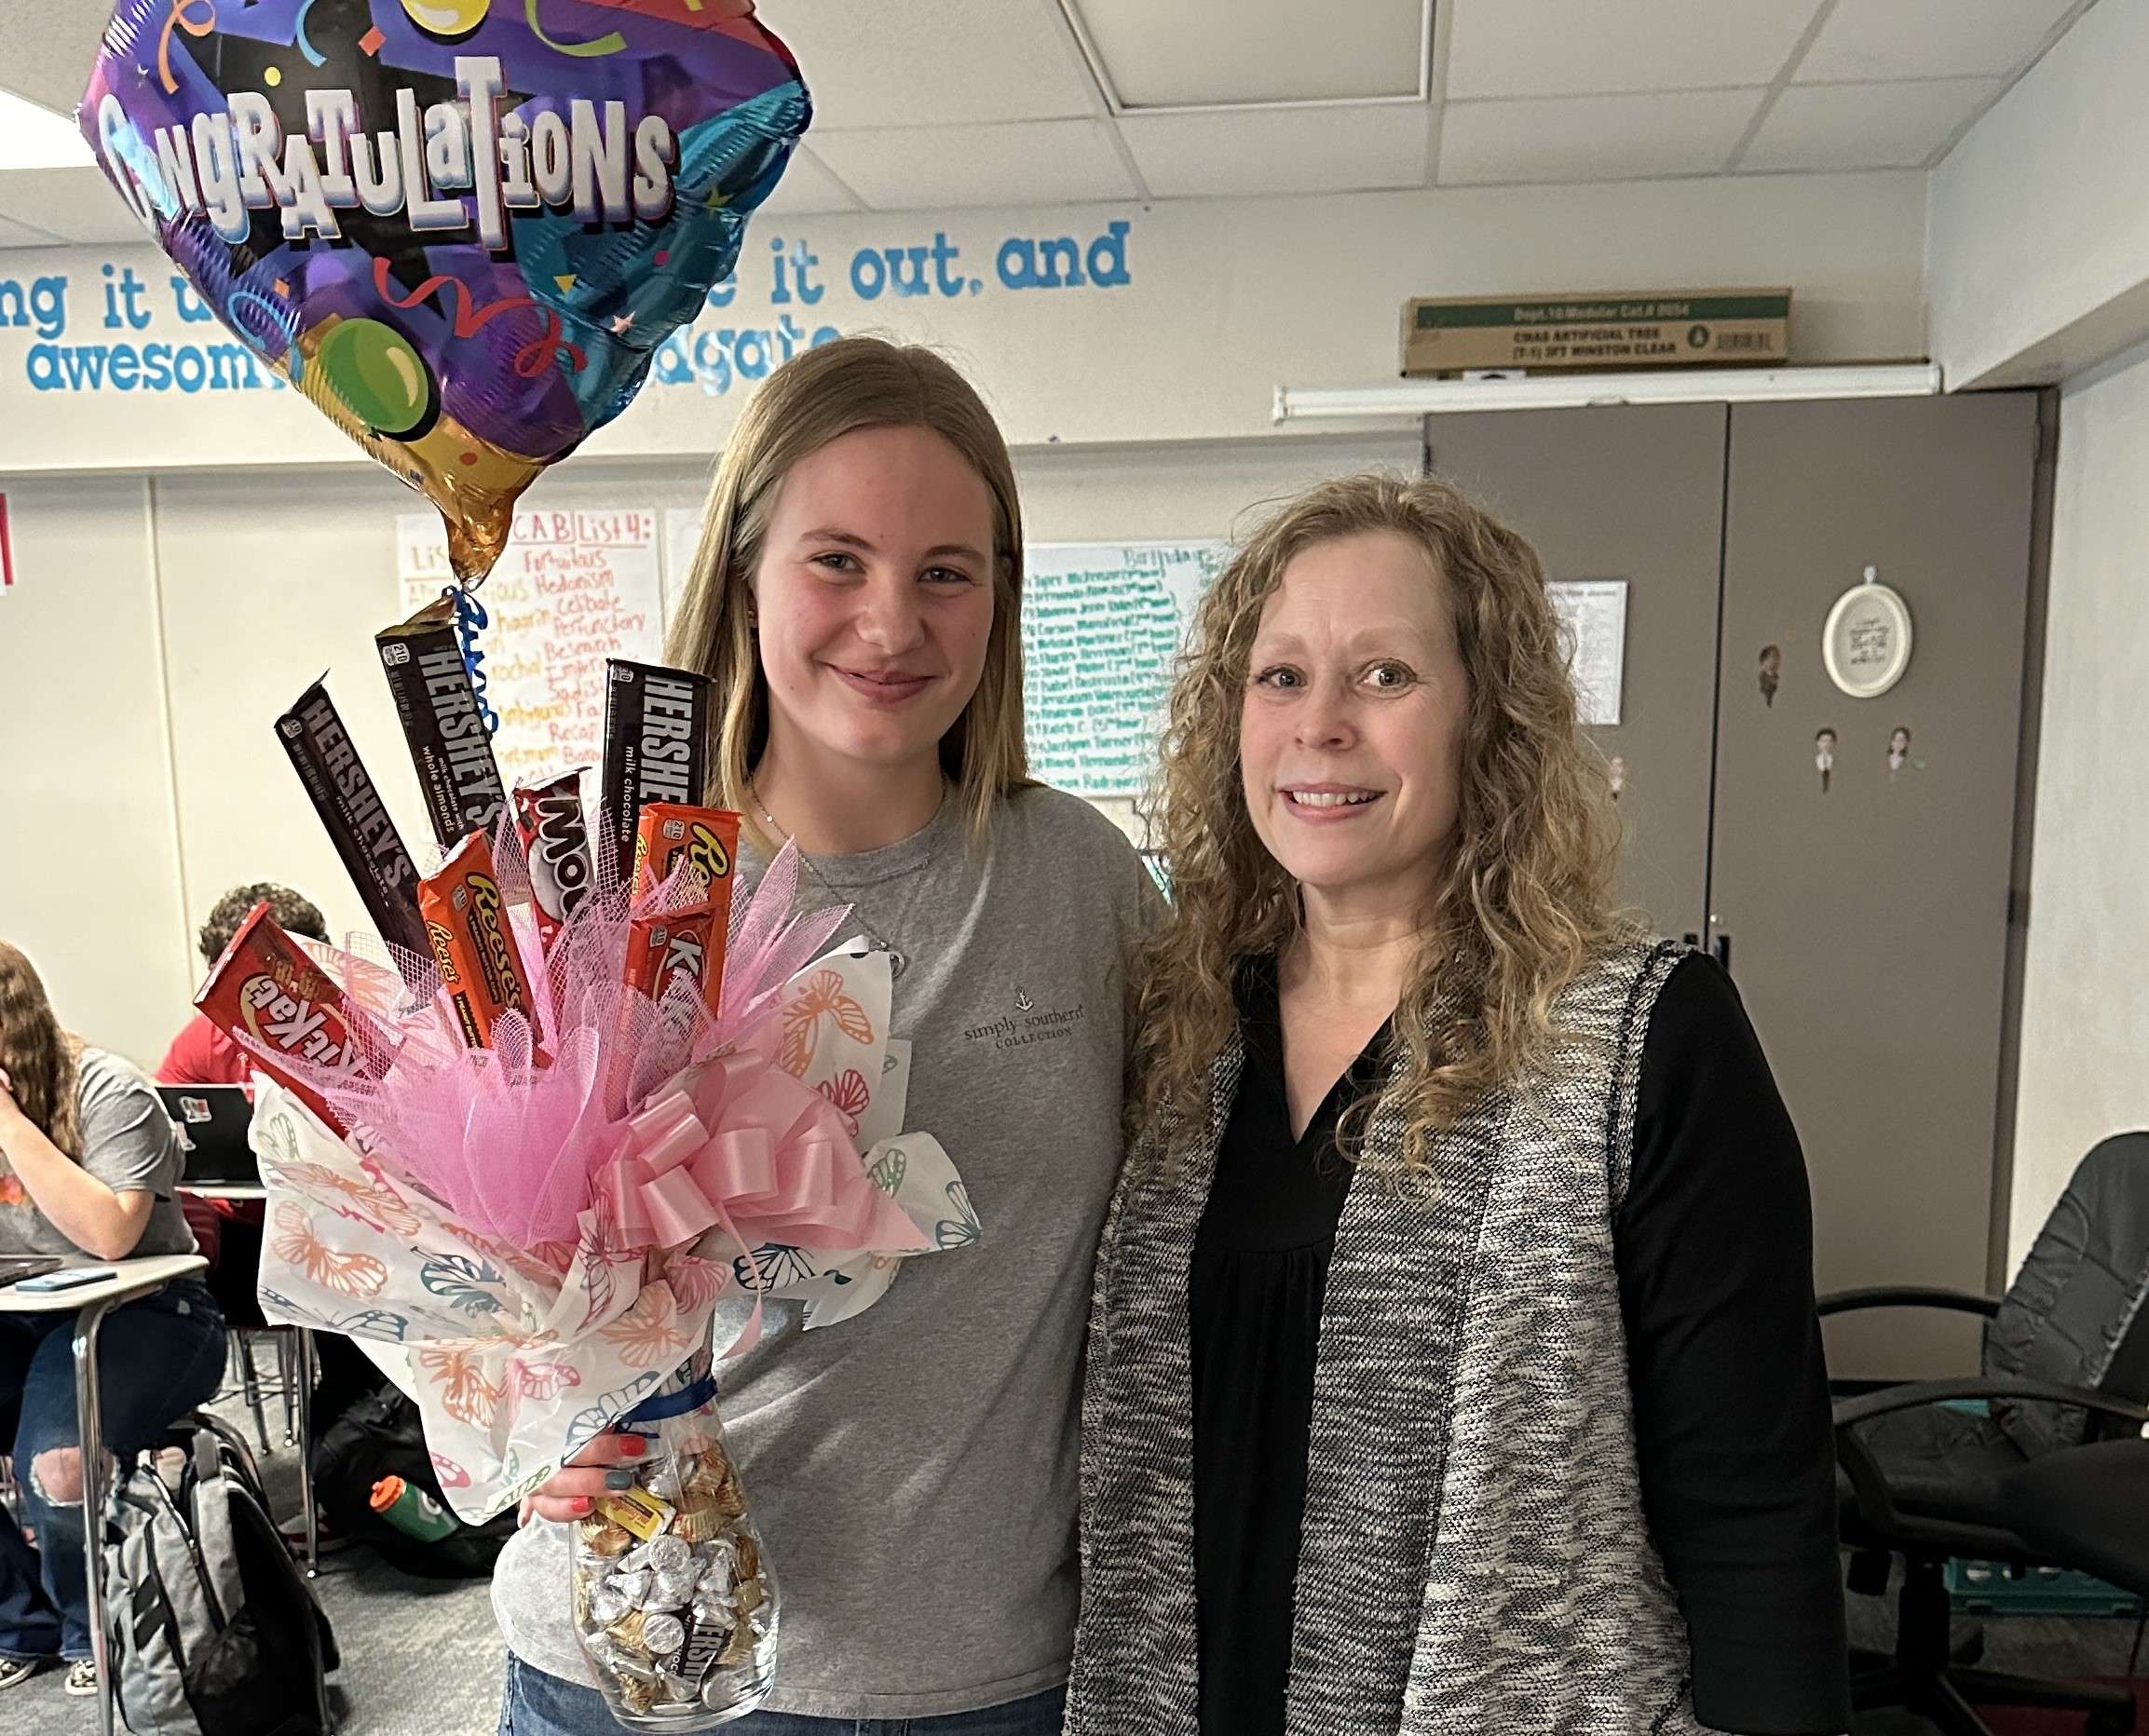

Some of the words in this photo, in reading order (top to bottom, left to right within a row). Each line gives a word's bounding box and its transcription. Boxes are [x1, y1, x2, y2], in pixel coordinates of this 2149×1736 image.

[769, 237, 824, 305] it
[996, 220, 1132, 290] and
[102, 264, 152, 330] it
[1553, 327, 1624, 343] ARTIFICIAL
[1571, 343, 1630, 357] WINSTON
[1634, 342, 1676, 355] CLEAR
[578, 514, 620, 542] List
[417, 650, 505, 826] HERSHEY'S
[623, 745, 637, 774] milk
[300, 698, 411, 888] HERSHEY'S
[421, 745, 439, 781] whole
[434, 783, 455, 834] almonds
[620, 779, 636, 843] chocolate
[334, 794, 355, 828] milk
[352, 827, 388, 895] chocolate
[427, 920, 460, 983] Reese's
[467, 873, 522, 1009] Reese's
[964, 1016, 1017, 1040] simply
[1025, 1007, 1085, 1028] southern
[995, 1026, 1072, 1050] COLLECTION
